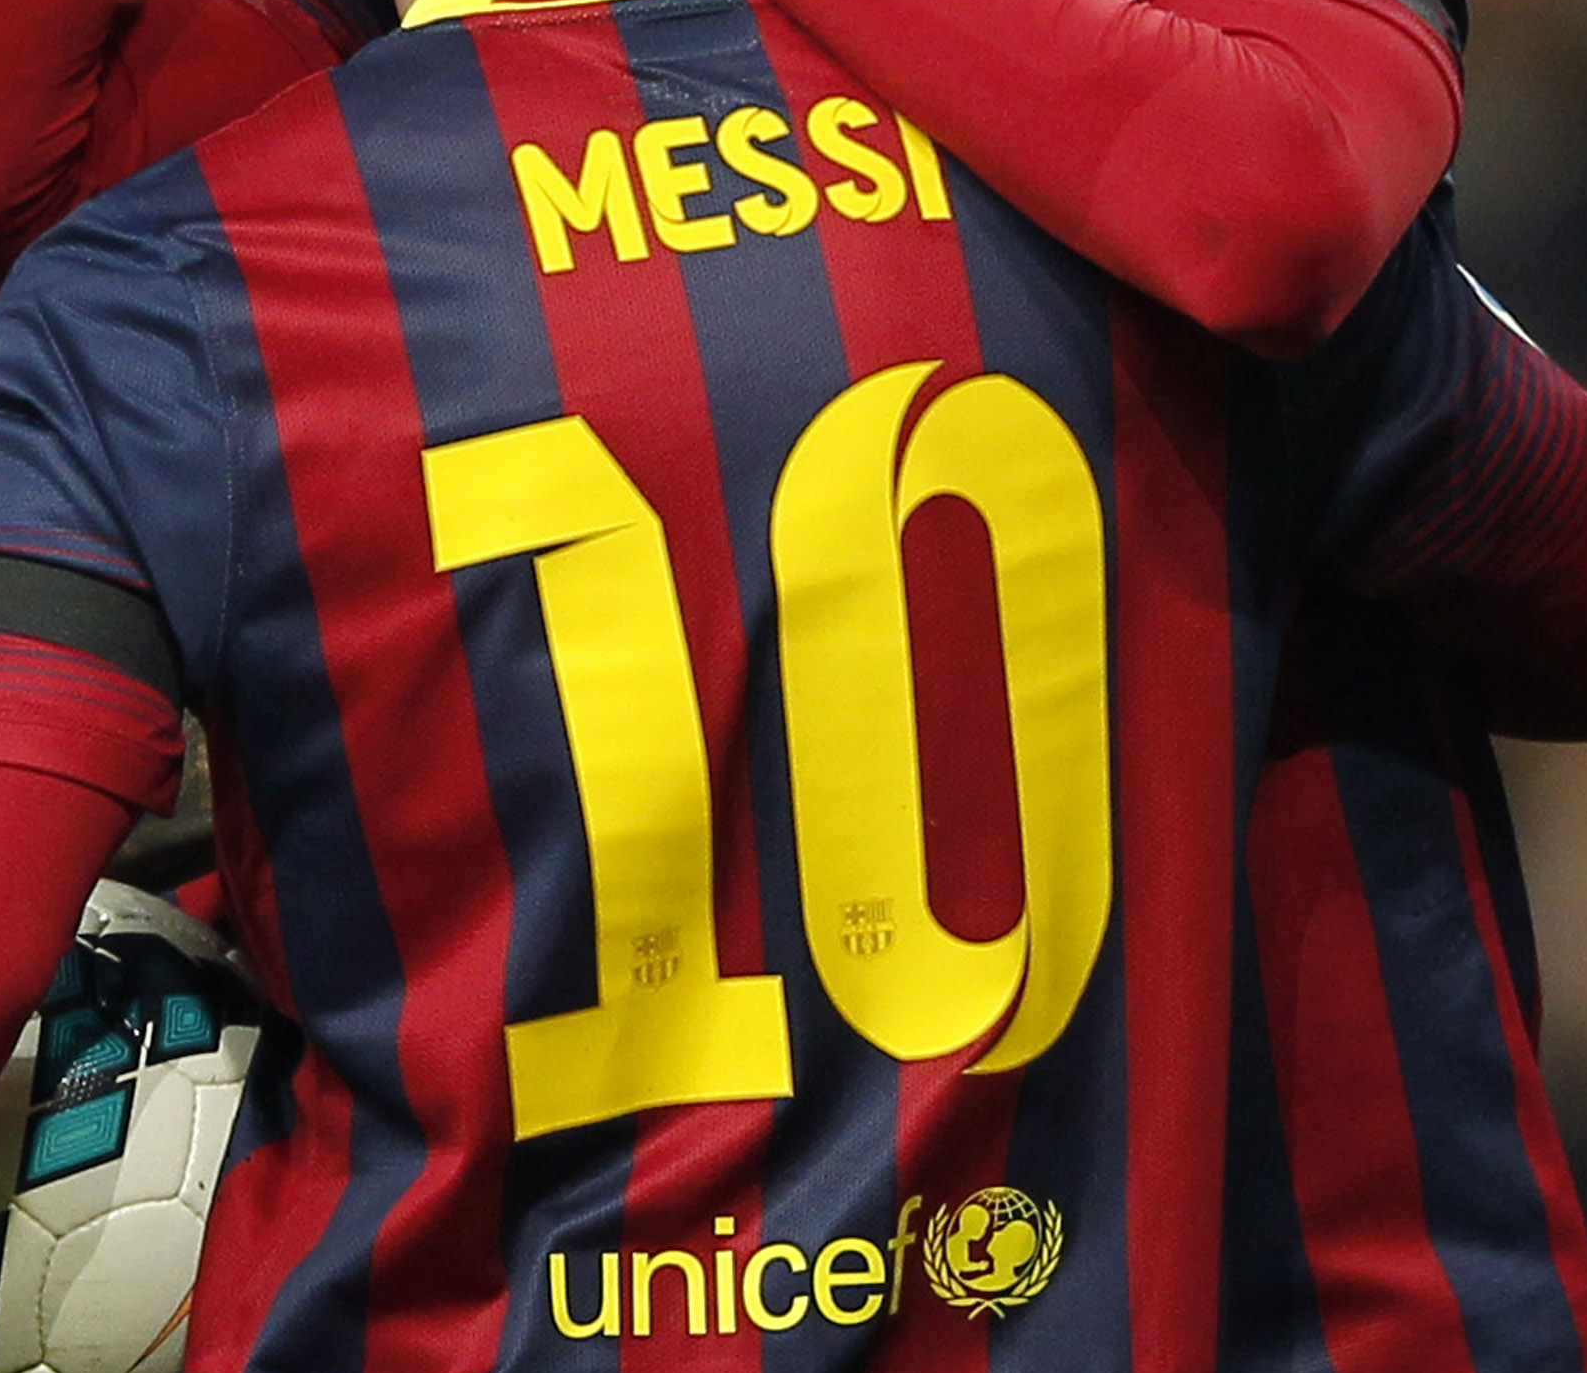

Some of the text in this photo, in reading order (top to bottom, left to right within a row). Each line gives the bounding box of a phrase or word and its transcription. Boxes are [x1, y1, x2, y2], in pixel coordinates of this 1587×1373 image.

[511, 96, 953, 273] MESSI
[422, 359, 1113, 1141] 10
[549, 1195, 922, 1339] unicef
